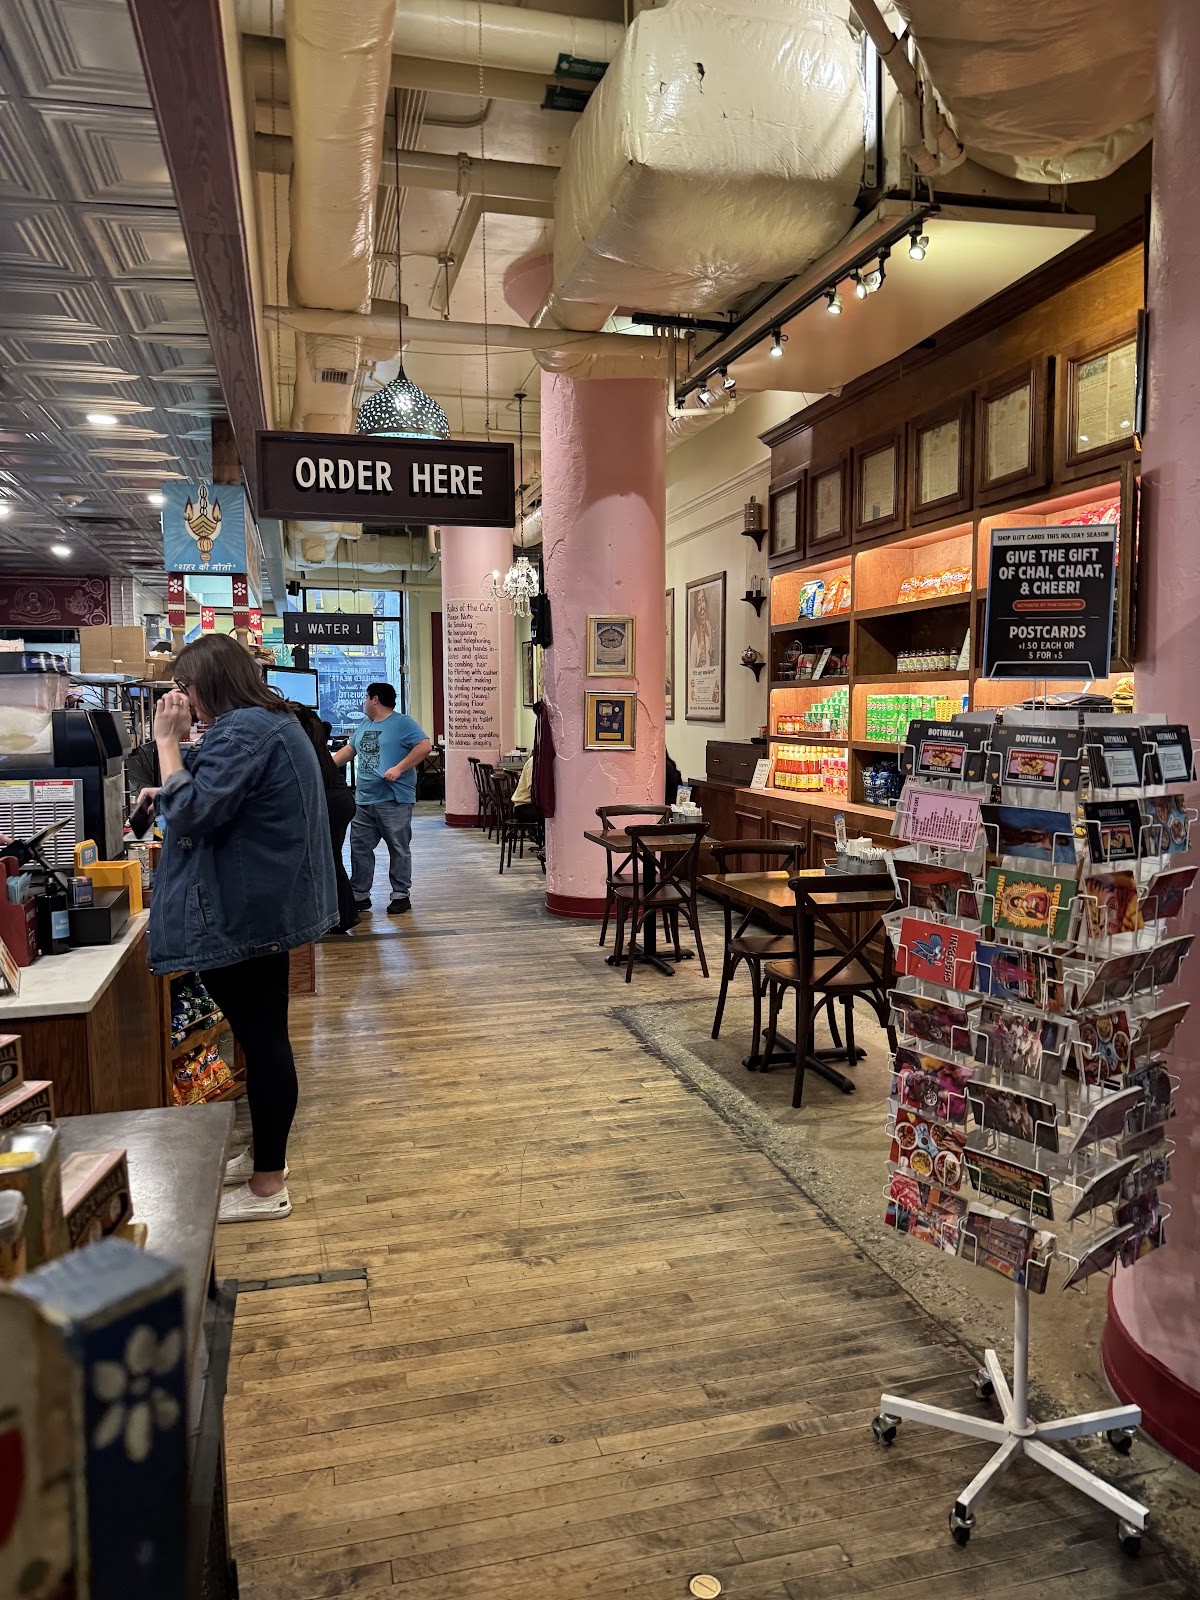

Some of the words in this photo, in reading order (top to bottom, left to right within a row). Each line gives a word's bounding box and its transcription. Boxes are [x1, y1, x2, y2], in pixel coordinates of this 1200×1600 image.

[296, 456, 394, 492] ORDER
[412, 463, 482, 495] HERE
[1006, 550, 1036, 564] GIVE
[1040, 549, 1066, 562] THE
[1069, 548, 1099, 562] GIFT
[999, 566, 1016, 580] OF
[1018, 565, 1054, 580] CHAI,
[1057, 564, 1104, 579] CHAAT,
[1020, 582, 1030, 595] &
[1033, 580, 1081, 594] CHEER!
[460, 603, 465, 611] of
[308, 624, 349, 634] WATER
[1009, 625, 1086, 639] POSTCARDS
[928, 728, 964, 738] BOTIWALLA
[1016, 734, 1056, 744] BOTIWALLA
[996, 875, 1006, 898] PANI
